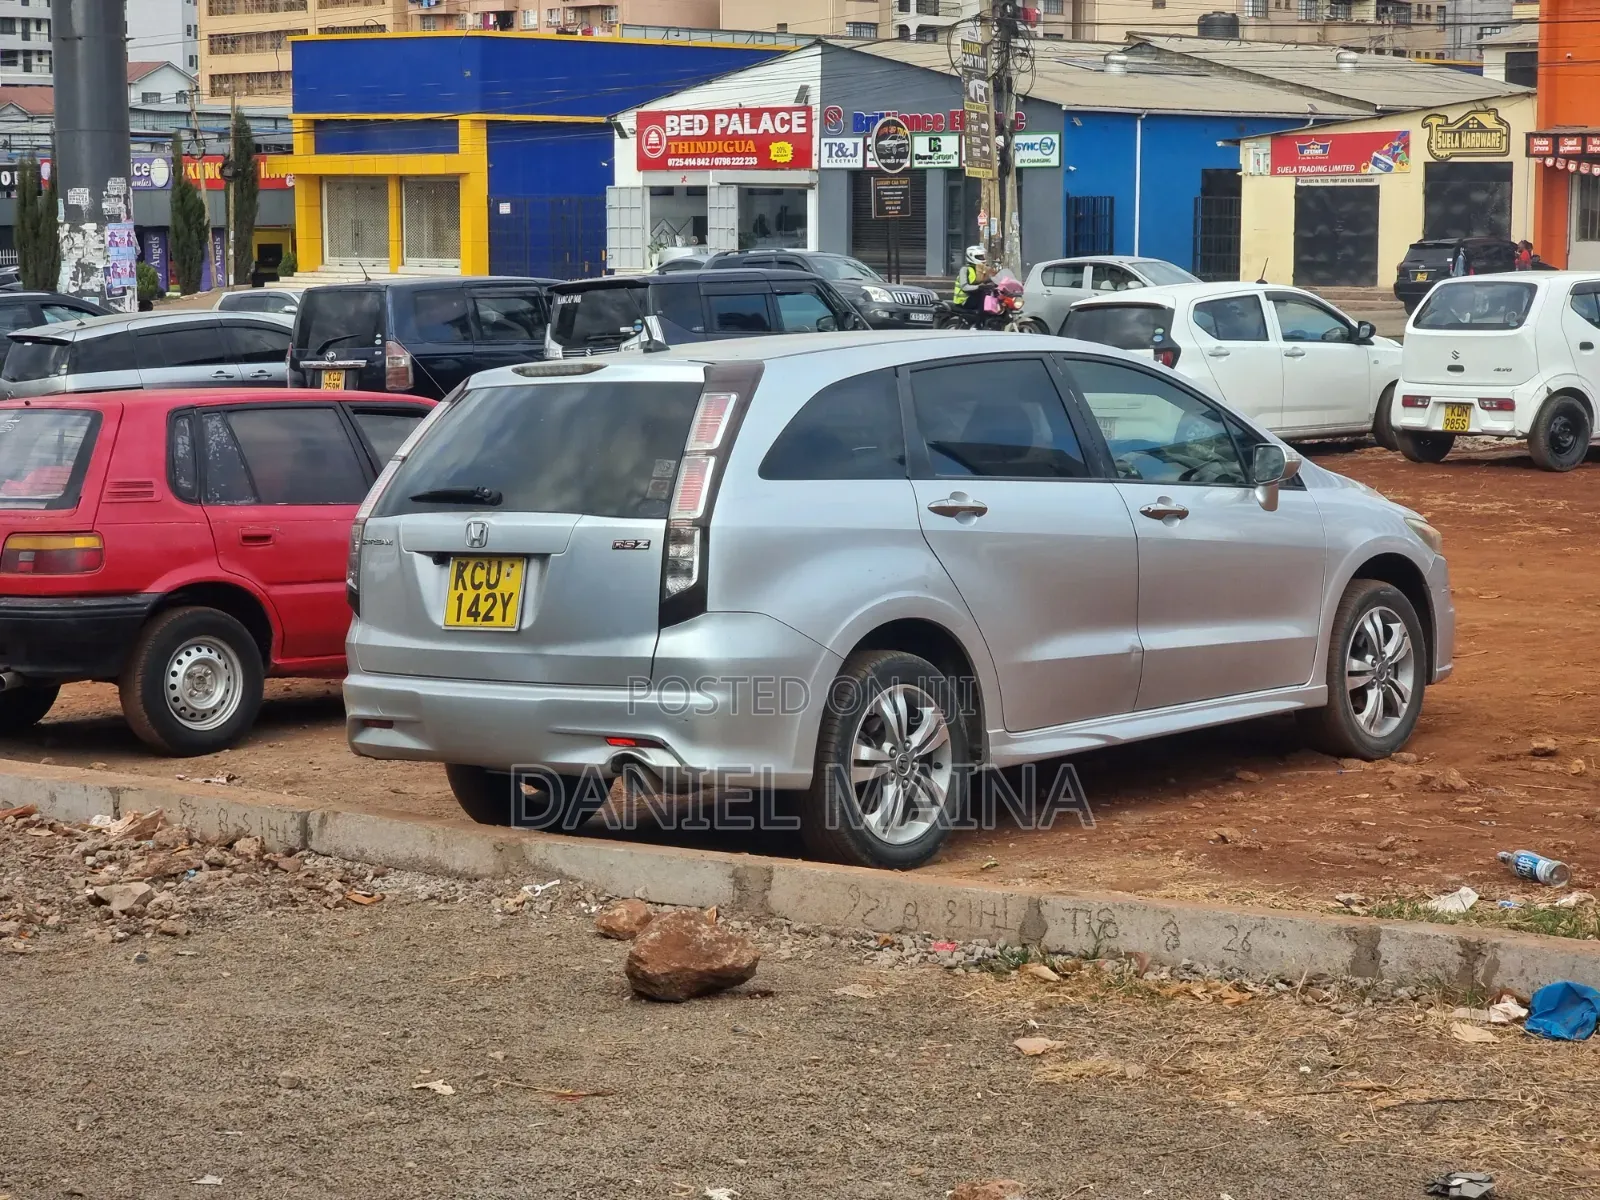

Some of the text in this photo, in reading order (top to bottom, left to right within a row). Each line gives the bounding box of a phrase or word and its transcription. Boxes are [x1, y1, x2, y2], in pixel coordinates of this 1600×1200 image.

[962, 40, 981, 55] LUXURY
[962, 53, 987, 70] CAR TINT
[665, 111, 807, 136] BED PALACE
[668, 140, 757, 155] THINDIGUA
[1437, 131, 1501, 148] SUELA HARDWARE
[824, 141, 859, 158] T&J
[914, 152, 954, 161] DuraGreen
[668, 158, 684, 166] 0725
[684, 158, 697, 166] 414
[715, 157, 731, 165] 0798
[731, 157, 745, 165] 222
[745, 157, 758, 165] 233
[1276, 164, 1355, 174] SUELA TRADING LIMITED
[149, 236, 162, 268] Angels
[214, 236, 222, 269] Angels
[1445, 417, 1467, 430] 985S
[612, 540, 650, 549] RSZ
[453, 560, 501, 590] KCU
[455, 592, 514, 623] 142Y
